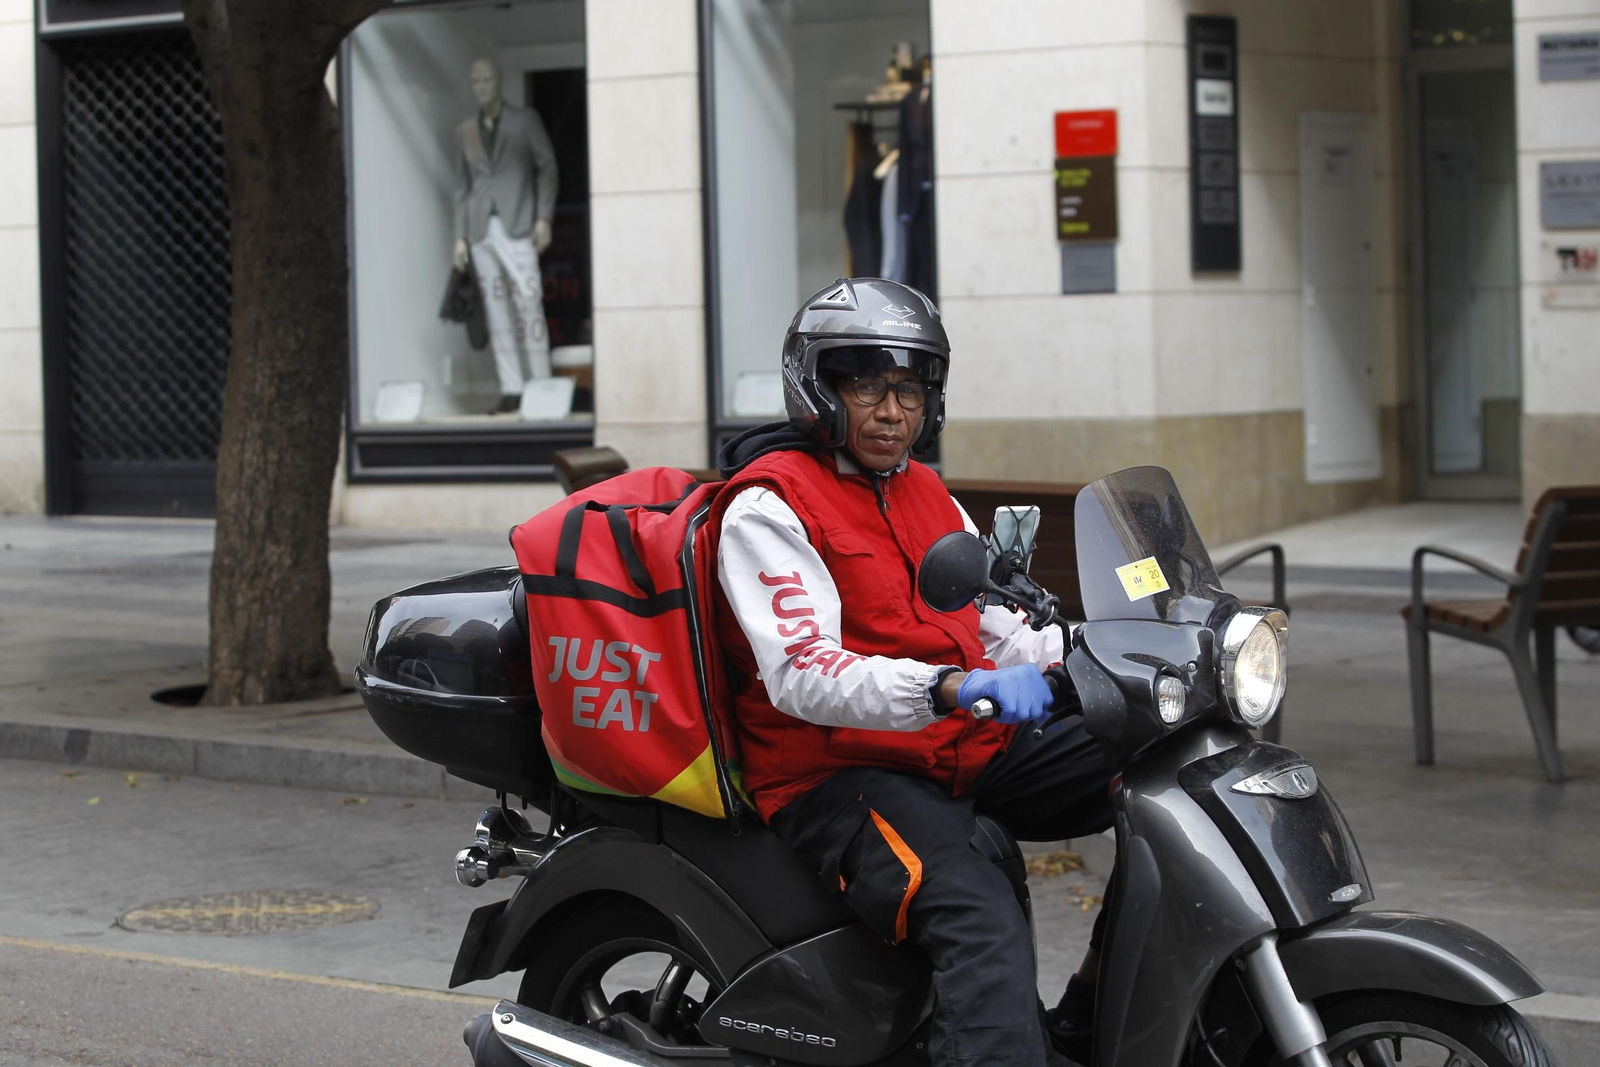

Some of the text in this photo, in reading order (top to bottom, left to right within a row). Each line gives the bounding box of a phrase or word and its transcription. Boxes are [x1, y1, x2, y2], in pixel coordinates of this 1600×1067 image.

[1149, 569, 1160, 580] 20
[548, 635, 662, 685] JUST
[572, 686, 659, 732] EAT
